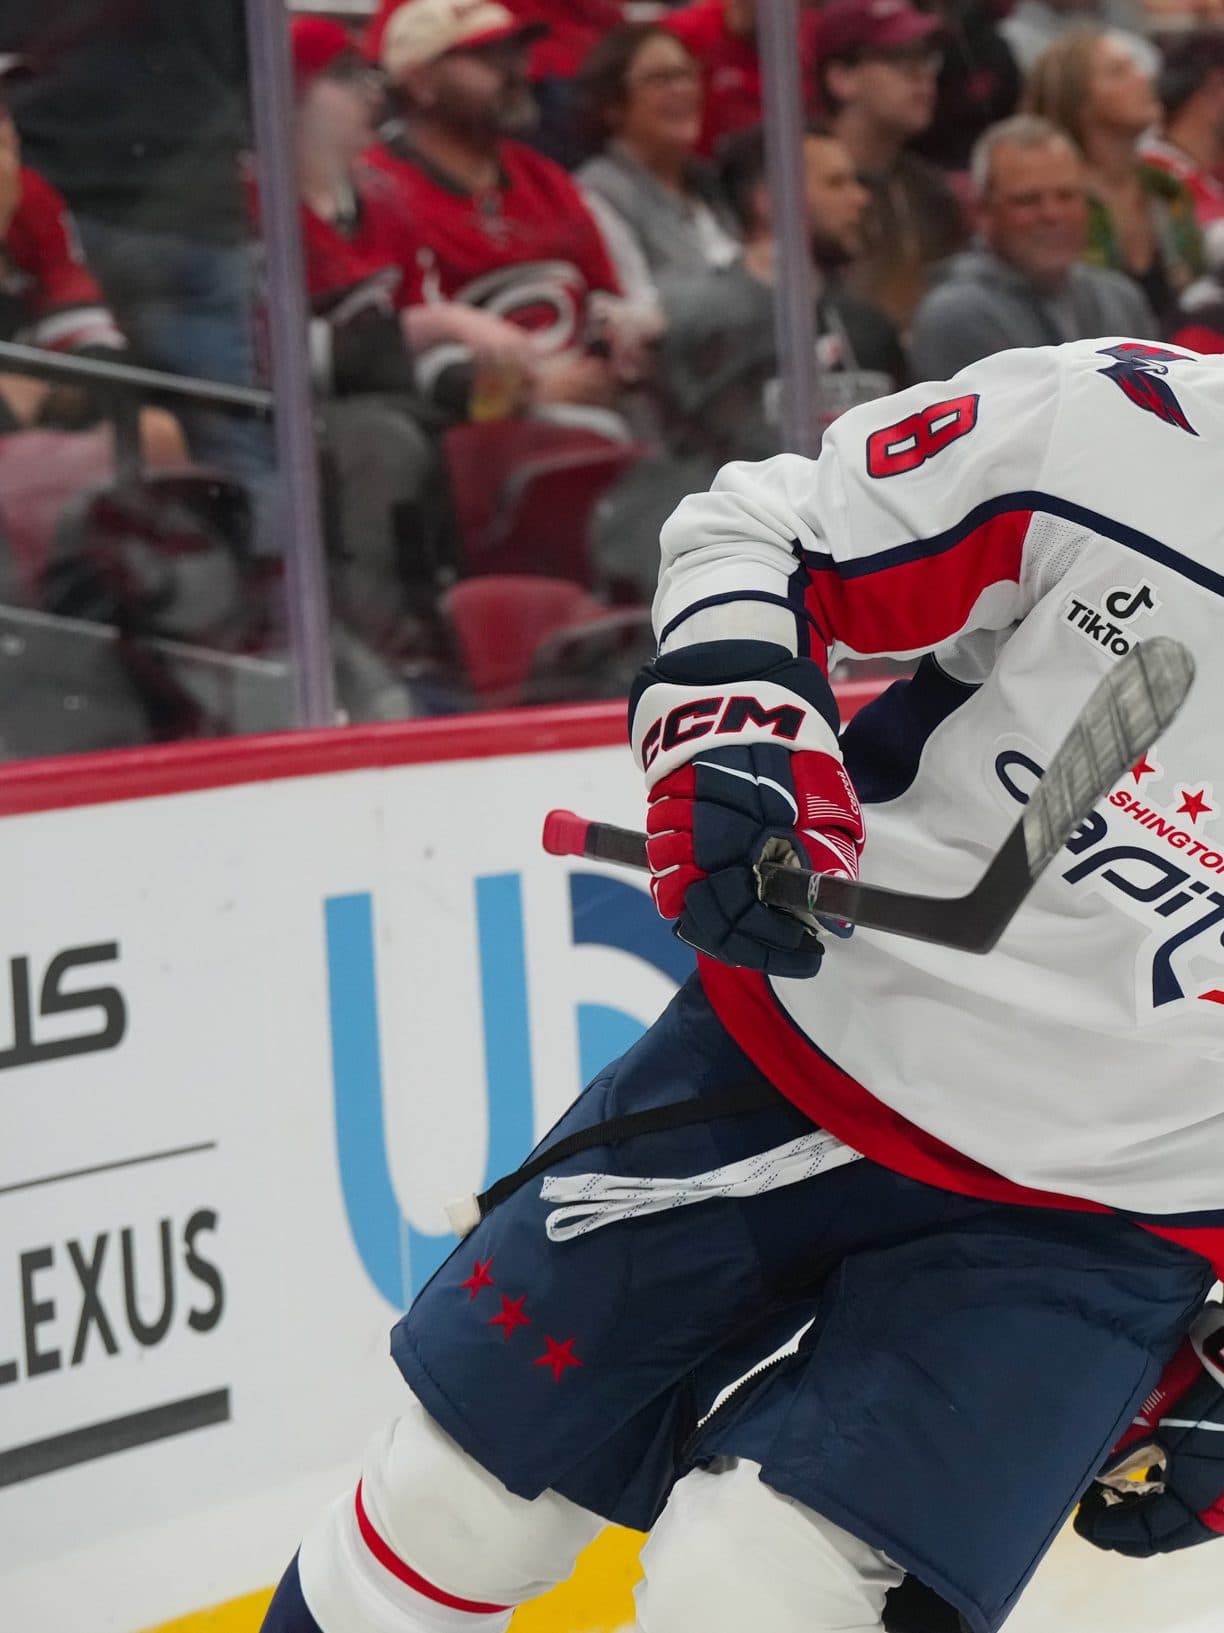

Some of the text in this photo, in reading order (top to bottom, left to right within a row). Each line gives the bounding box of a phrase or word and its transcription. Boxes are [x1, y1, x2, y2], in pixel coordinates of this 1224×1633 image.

[866, 393, 980, 479] 8
[1067, 599, 1130, 656] TikTo
[641, 695, 807, 772] CCM
